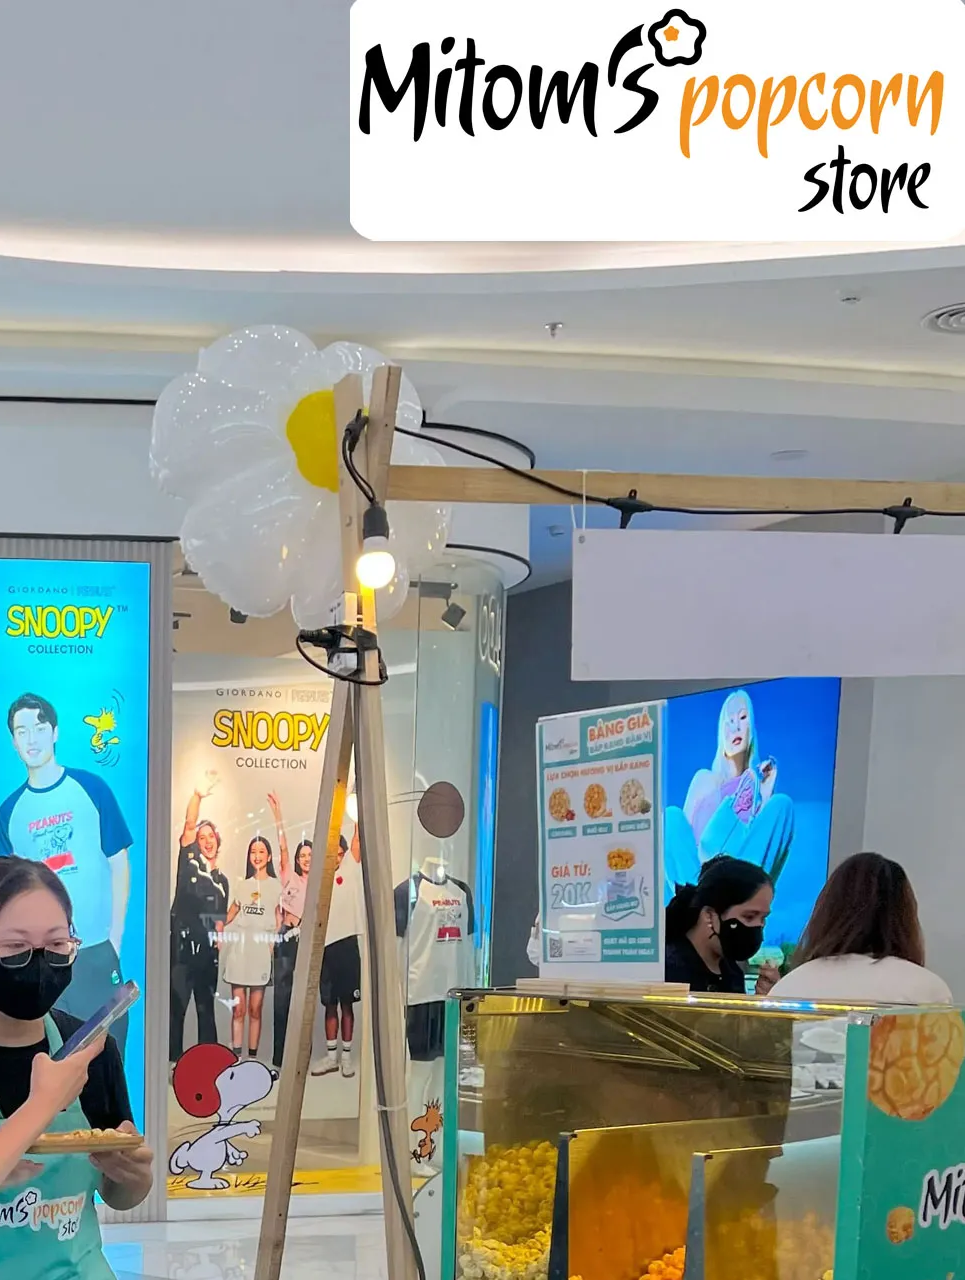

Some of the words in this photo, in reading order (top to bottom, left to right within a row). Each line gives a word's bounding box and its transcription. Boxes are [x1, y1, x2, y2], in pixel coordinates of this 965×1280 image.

[8, 586, 68, 594] GIORDANO
[5, 603, 114, 639] SNOOPY
[27, 644, 93, 654] COLLECTION
[216, 688, 282, 698] GIORDANO
[211, 709, 331, 752] SNOOPY
[588, 718, 625, 742] BẢNG
[627, 706, 651, 731] GIÁ
[235, 757, 307, 769] COLLECTION
[551, 862, 571, 878] GIÁ
[551, 881, 592, 909] 20K
[922, 1168, 965, 1223] Mi
